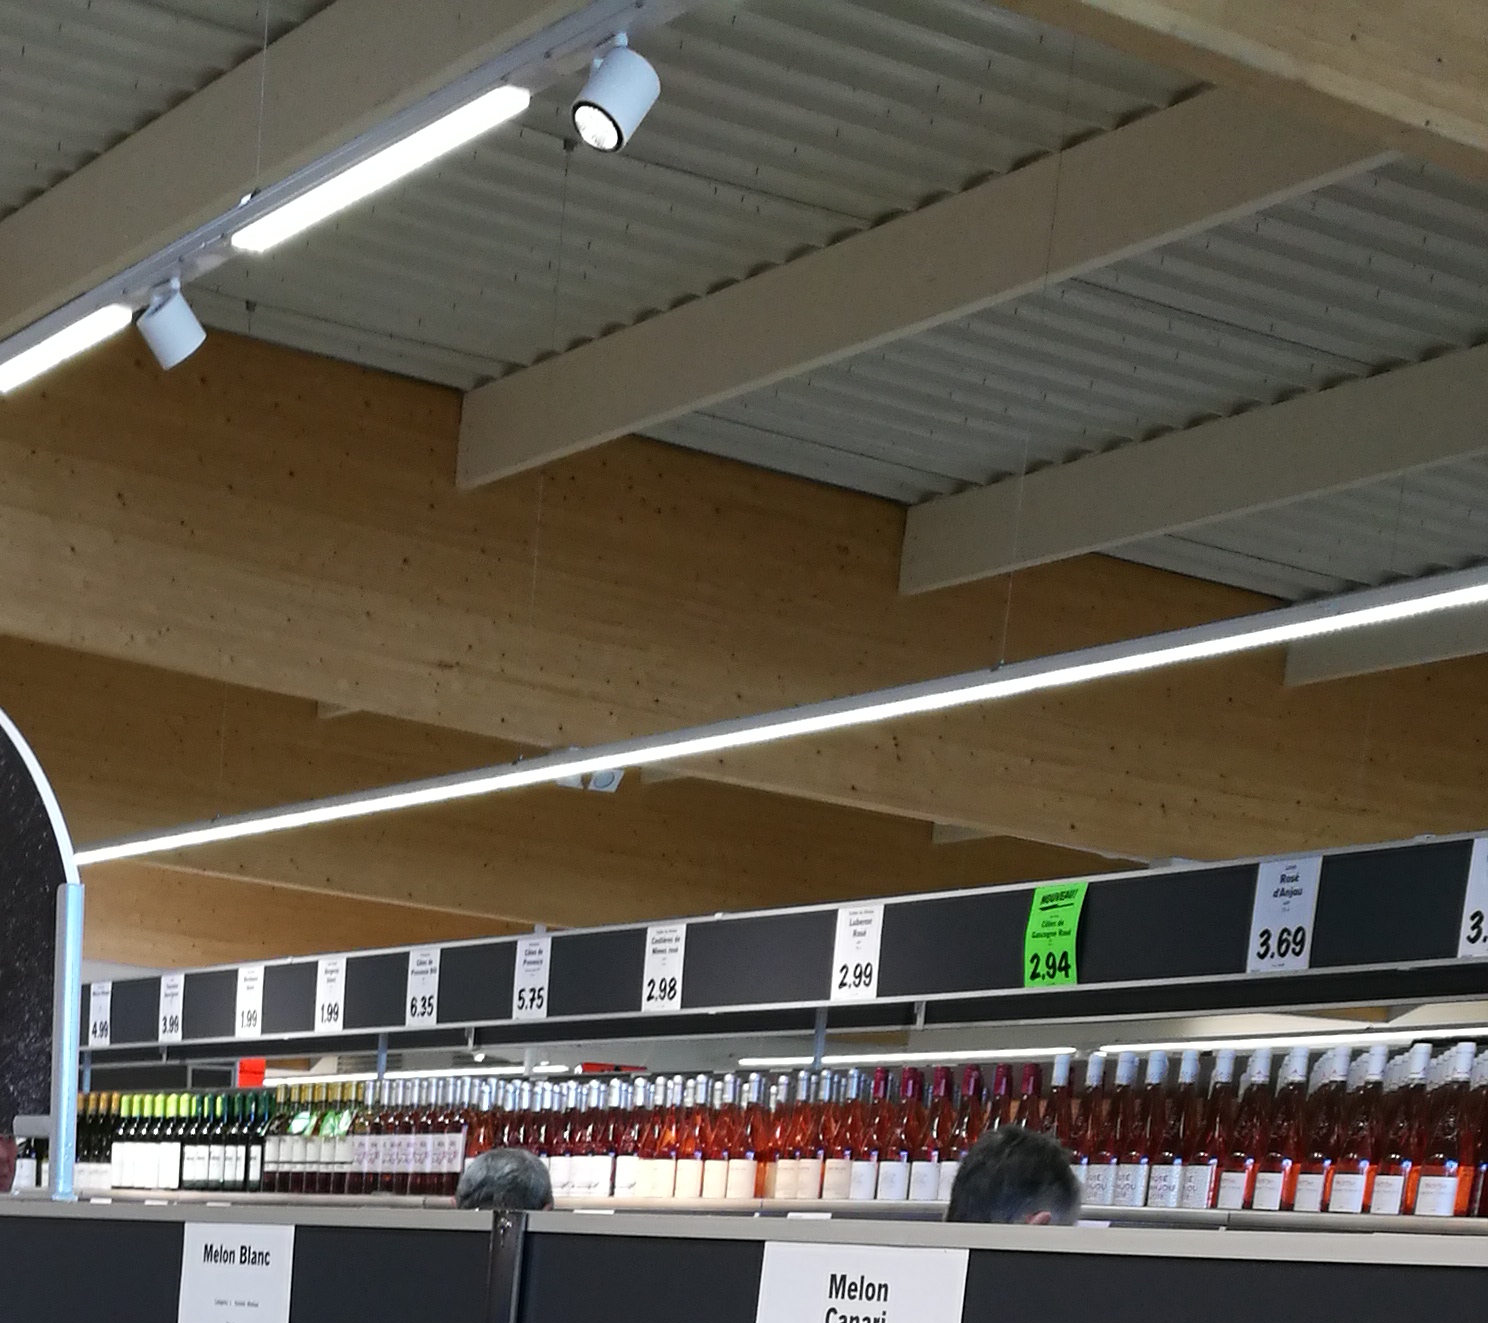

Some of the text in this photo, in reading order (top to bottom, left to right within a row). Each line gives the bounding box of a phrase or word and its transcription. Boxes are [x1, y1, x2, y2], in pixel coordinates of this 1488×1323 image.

[1279, 873, 1300, 884] Rosé
[1041, 888, 1079, 905] NOUVEAU!
[1272, 886, 1303, 898] d'Anjou
[1256, 925, 1306, 960] 3.69
[838, 962, 873, 989] 2.99
[1029, 950, 1071, 980] 2.94
[517, 986, 544, 1010] 5.75
[646, 976, 677, 1001] 2.98
[320, 1002, 340, 1023] 1.99
[410, 995, 434, 1018] 6.35
[92, 1021, 109, 1039] 4.99
[162, 1015, 180, 1034] 3.99
[240, 1010, 258, 1028] 1.99
[203, 1243, 271, 1267] Melon Blanc
[828, 1273, 889, 1302] Melon
